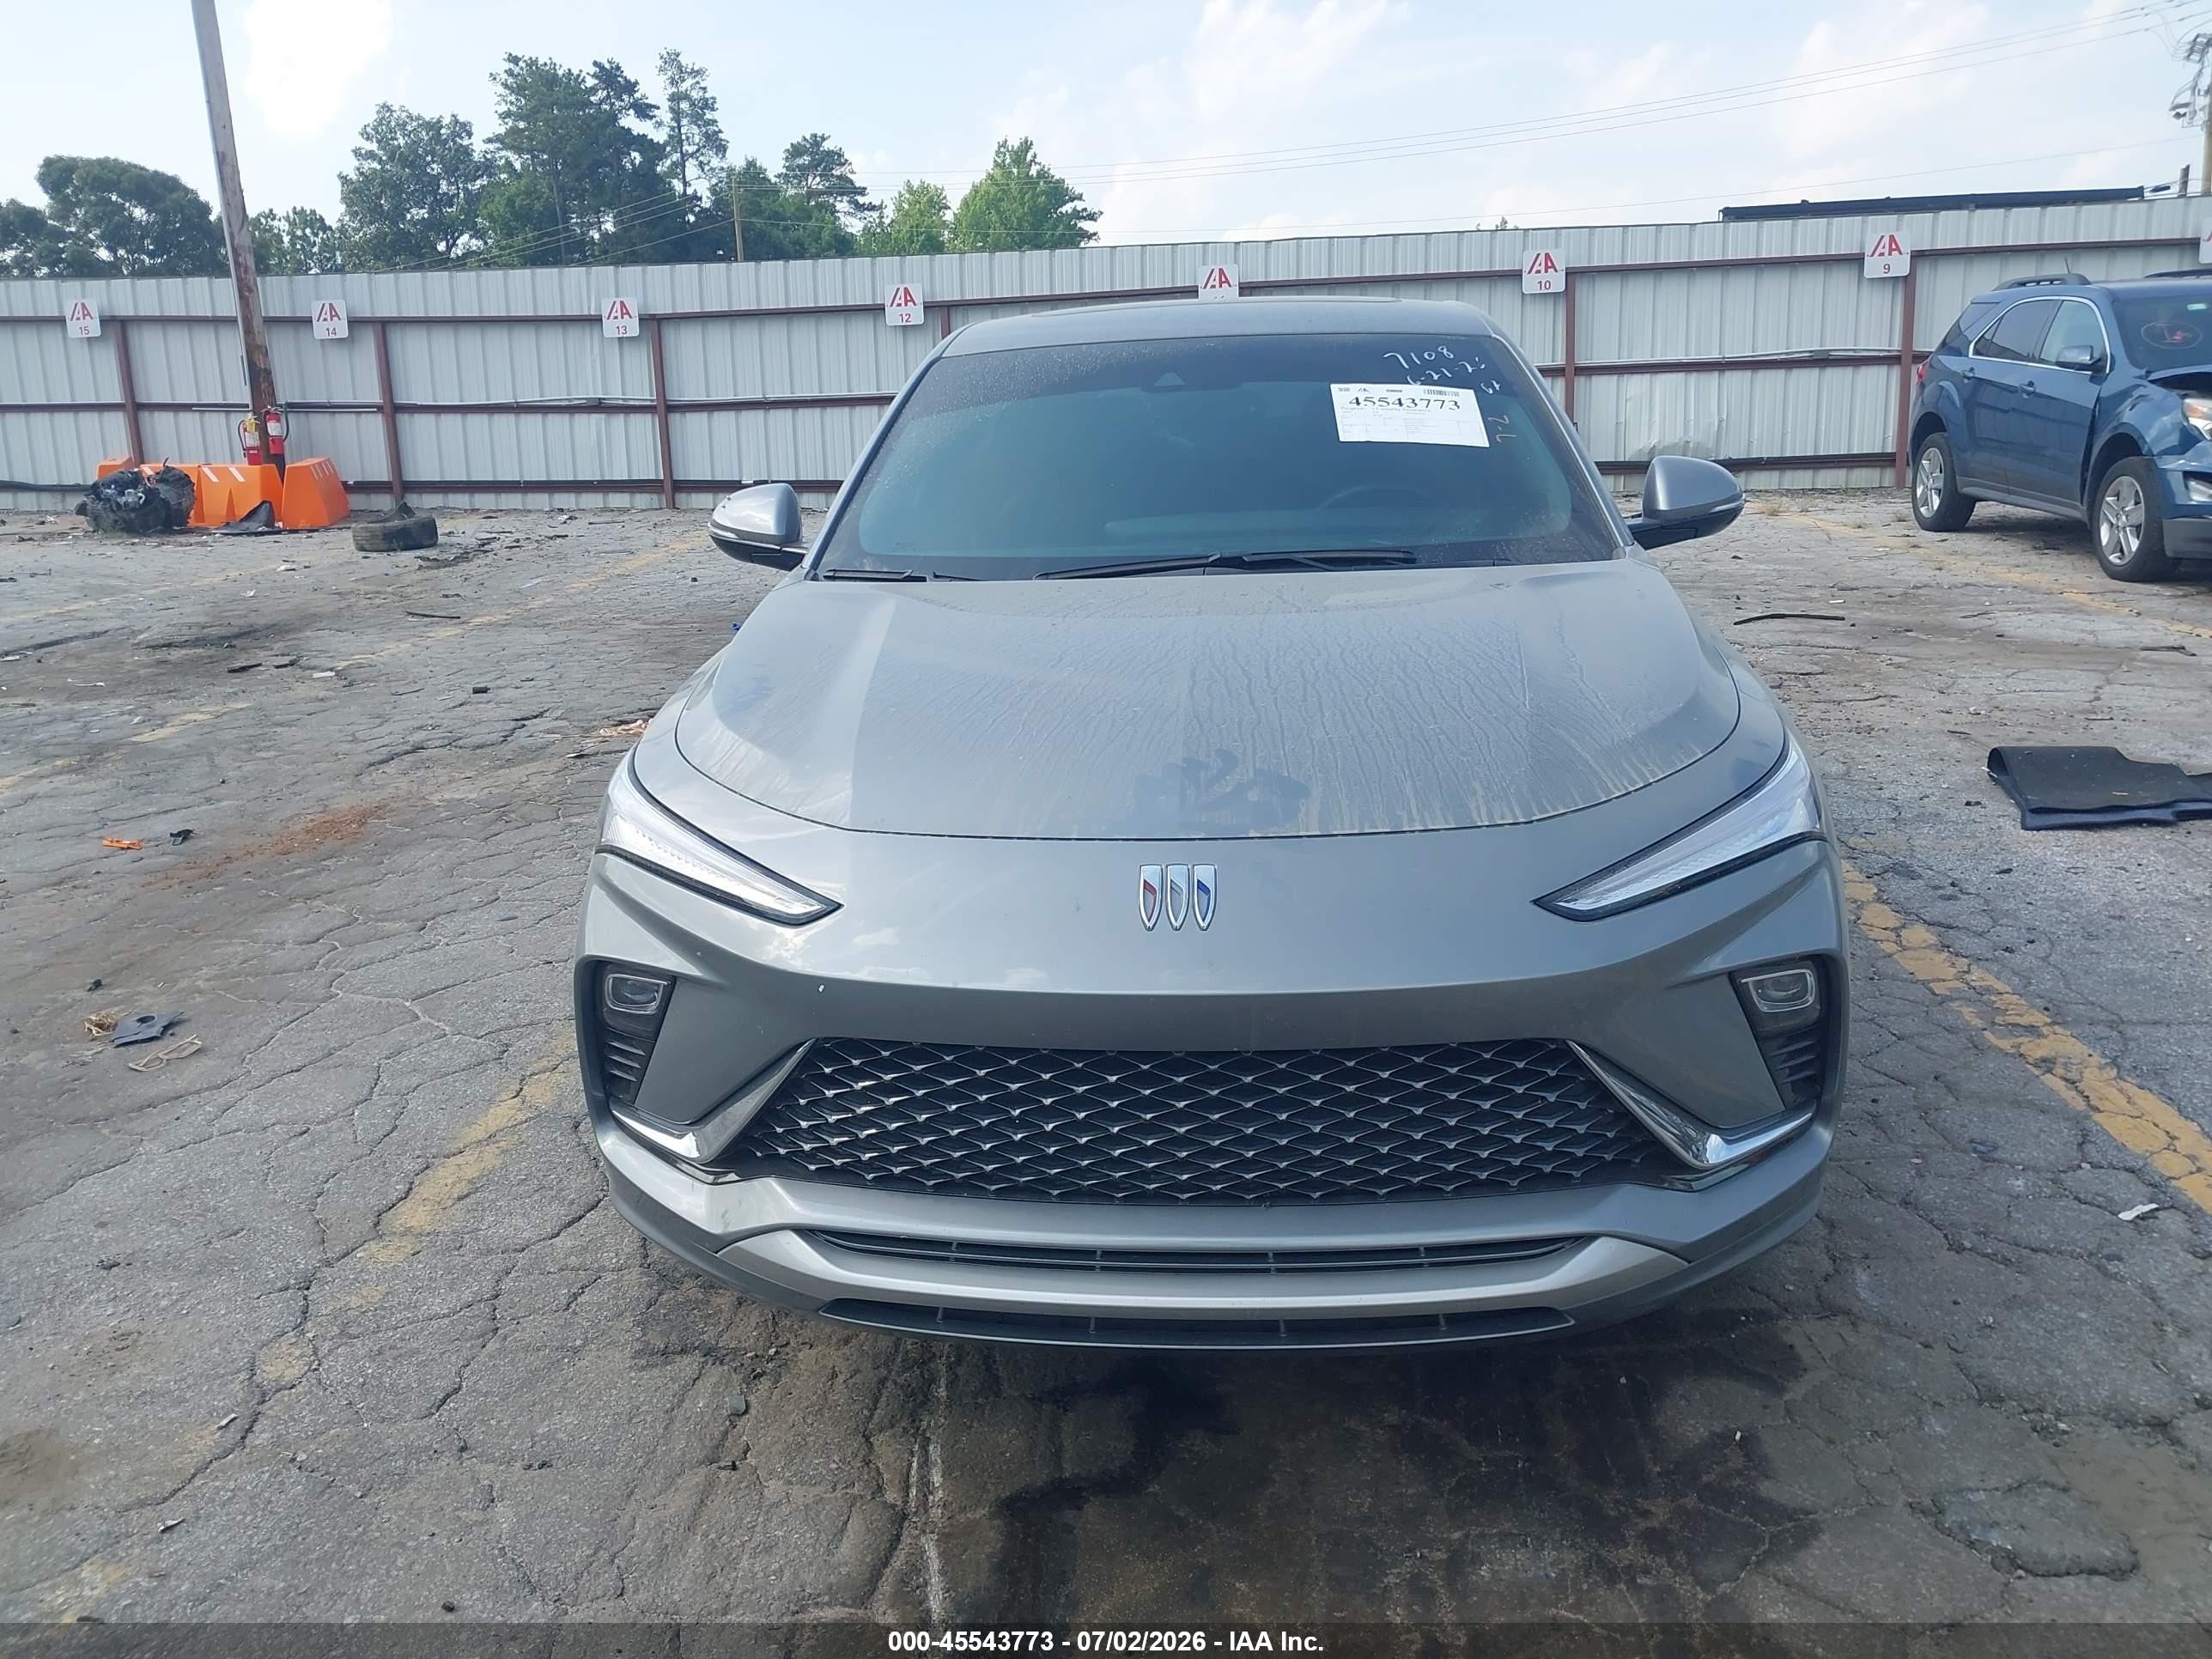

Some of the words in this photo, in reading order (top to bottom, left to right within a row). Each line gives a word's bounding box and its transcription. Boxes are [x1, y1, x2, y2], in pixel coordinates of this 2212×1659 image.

[1883, 263, 1891, 274] 9
[1537, 280, 1552, 290] 10
[899, 313, 912, 323] 12
[79, 325, 89, 336] 15
[325, 327, 337, 337] 14
[616, 325, 628, 335] 13
[1382, 345, 1455, 369] 7108
[1348, 396, 1460, 410] 45543773
